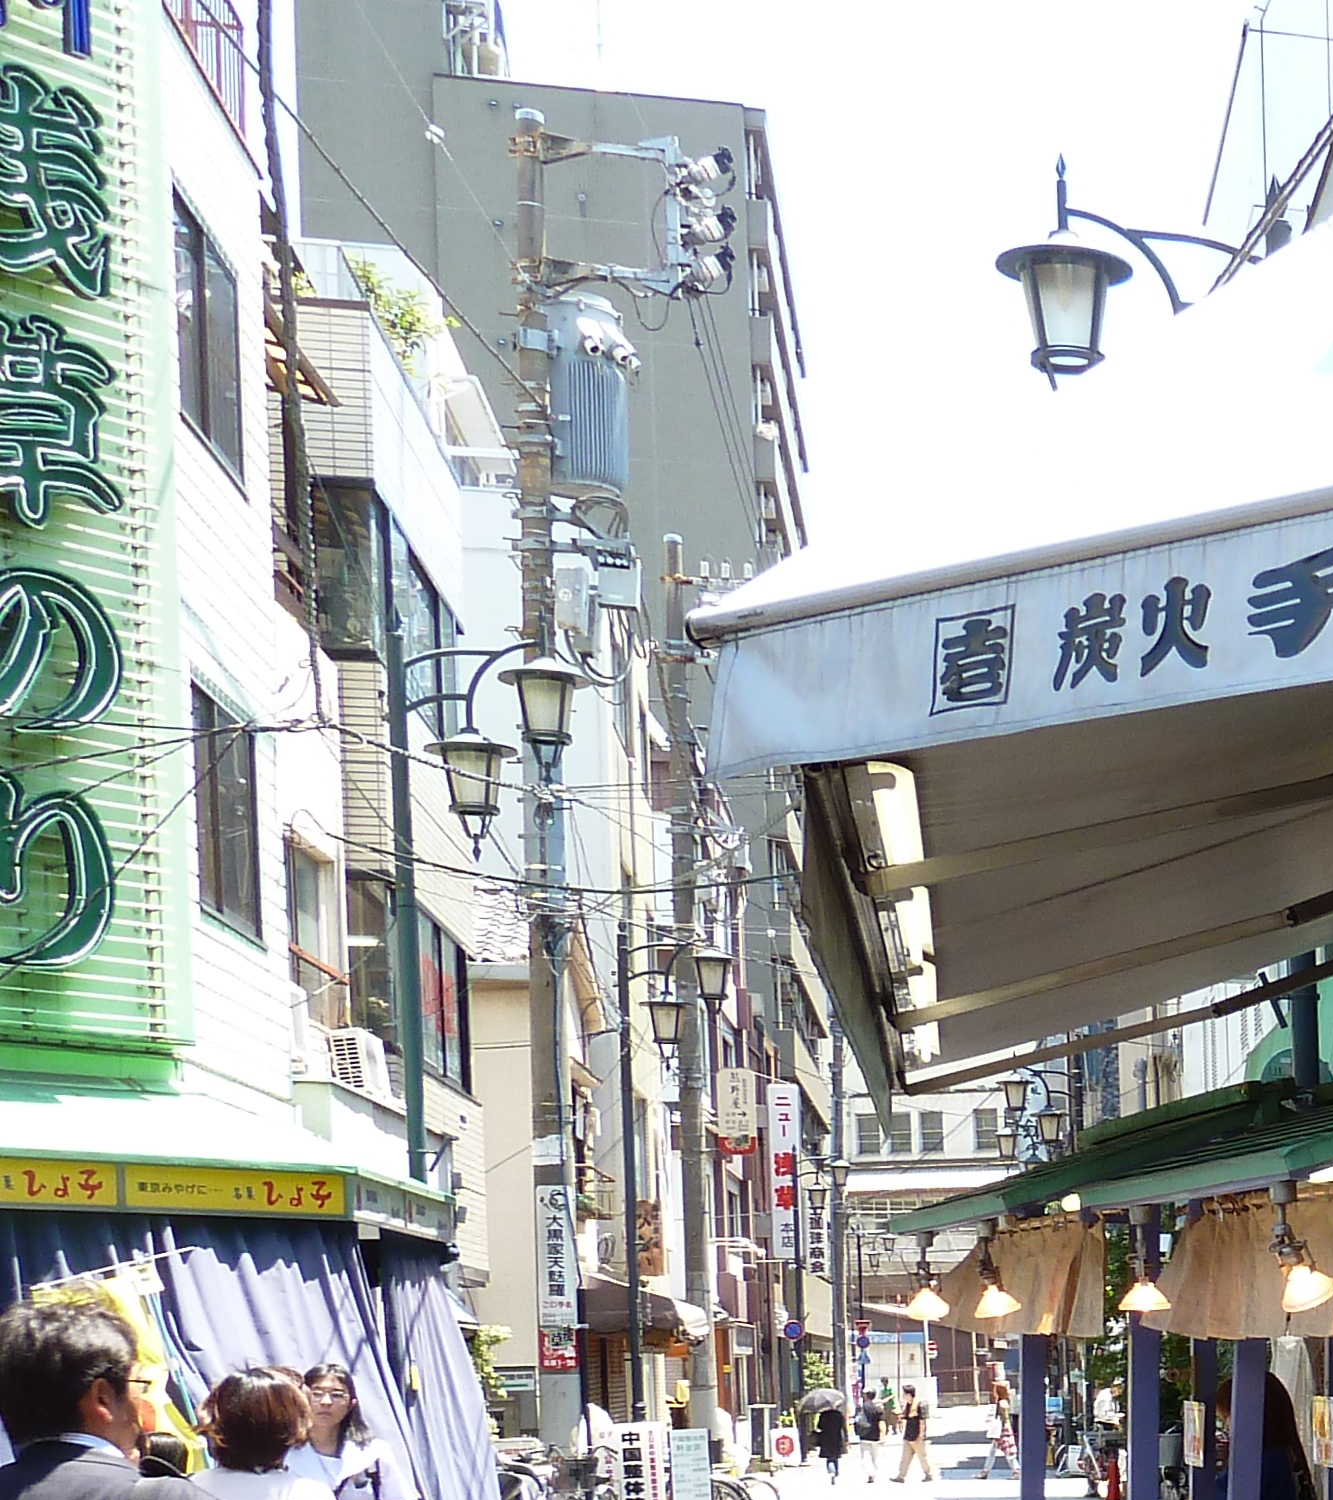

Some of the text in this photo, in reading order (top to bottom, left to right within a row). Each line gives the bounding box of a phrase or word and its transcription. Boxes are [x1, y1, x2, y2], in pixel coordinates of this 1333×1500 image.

[22, 1168, 104, 1200] ひよ子
[262, 1179, 333, 1209] ひよ子
